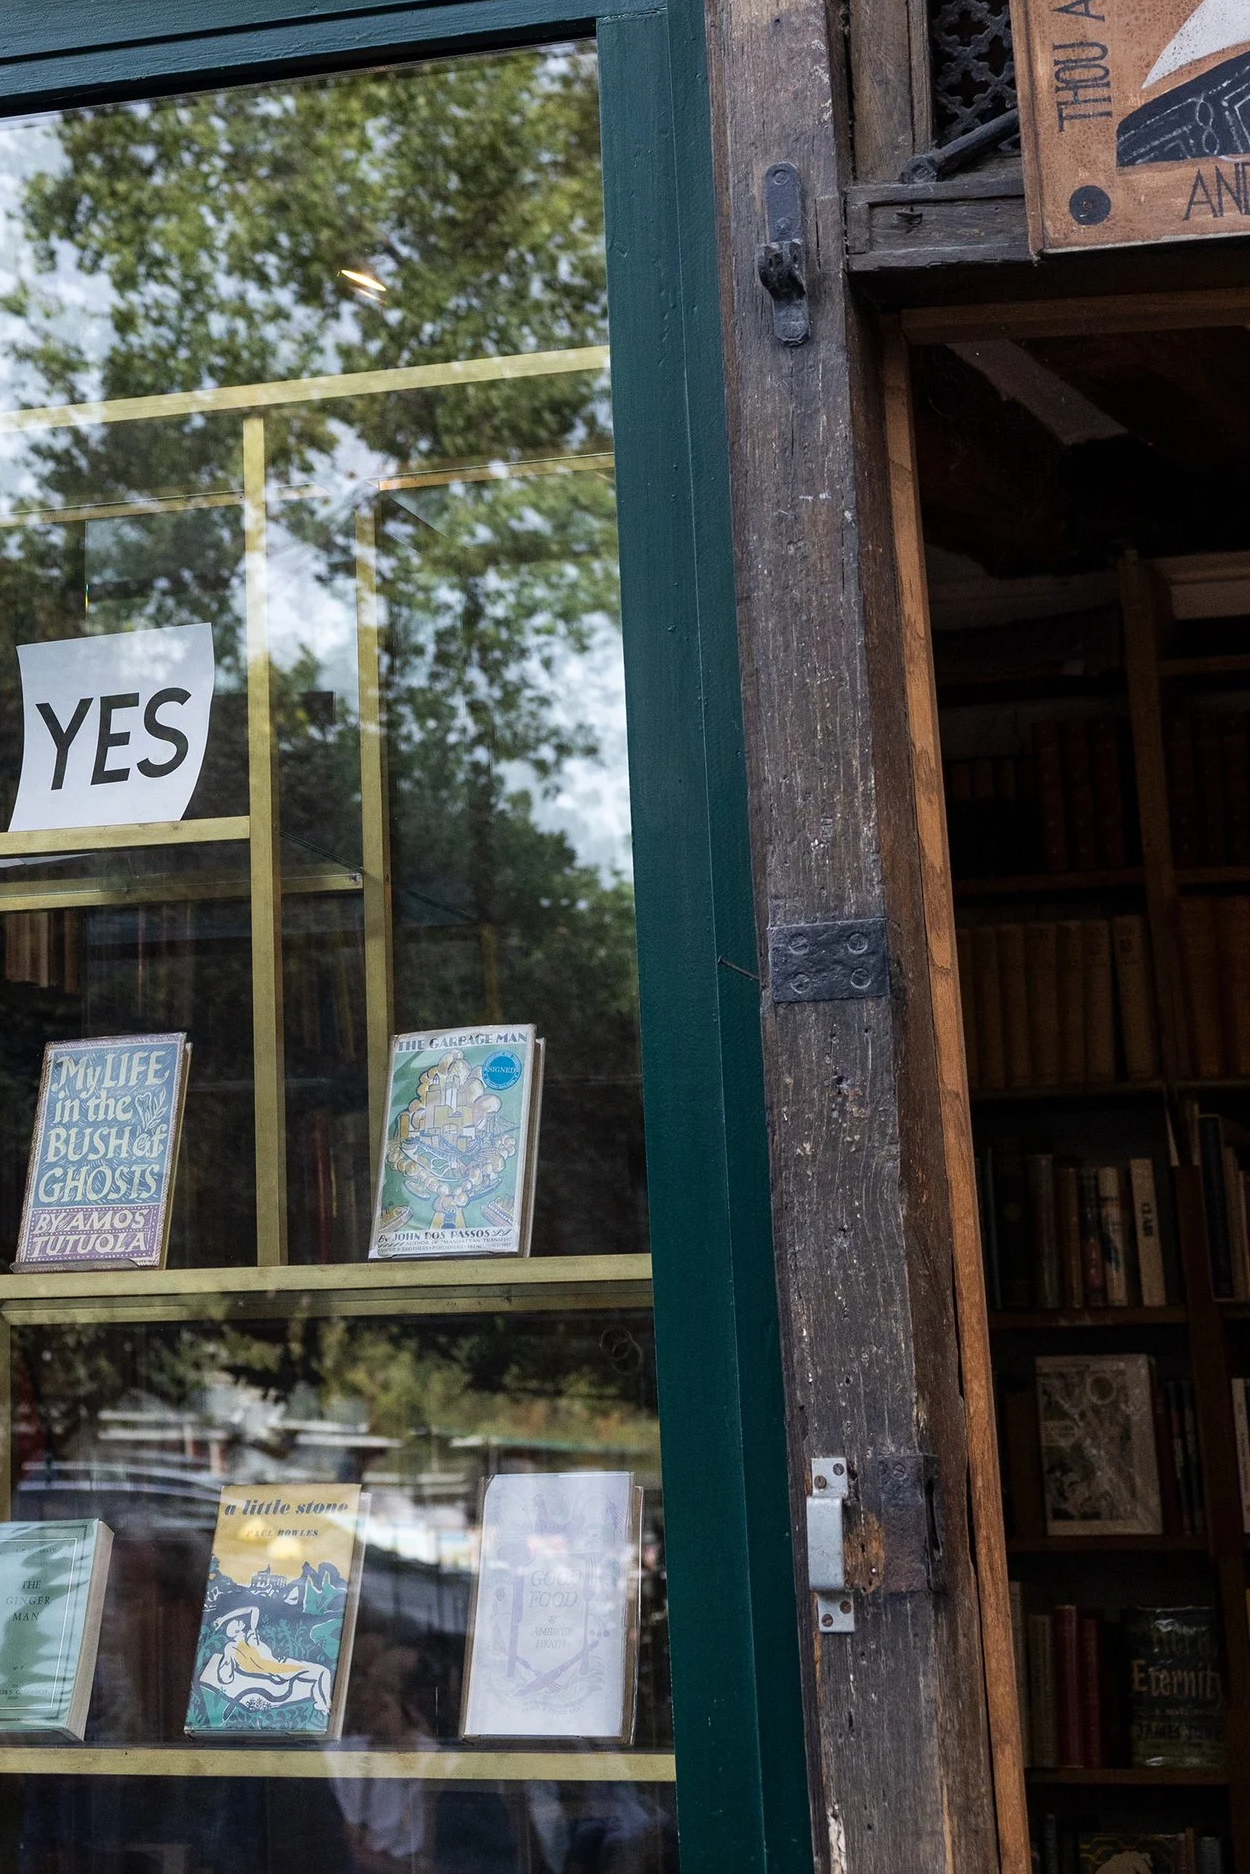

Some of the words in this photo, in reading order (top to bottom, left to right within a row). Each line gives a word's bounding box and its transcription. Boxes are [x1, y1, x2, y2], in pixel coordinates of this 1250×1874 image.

[1057, 40, 1112, 133] THOU
[34, 687, 192, 791] YES
[398, 1039, 425, 1052] THE
[430, 1033, 494, 1049] GARBAGE
[496, 1032, 528, 1044] MAN
[51, 1055, 103, 1098] My
[100, 1050, 170, 1088] LIFE
[489, 1066, 516, 1074] SIGNED
[52, 1090, 80, 1124] in
[86, 1088, 132, 1122] the
[45, 1124, 132, 1163] BUSH
[38, 1162, 160, 1203] GHOSTS
[32, 1210, 67, 1234] BY
[67, 1209, 149, 1230] AMOS
[29, 1233, 147, 1258] TUTUOLA
[393, 1232, 421, 1242] JOHN
[425, 1230, 445, 1240] DOS
[450, 1229, 490, 1239] PASSOS
[224, 1504, 237, 1515] a
[242, 1499, 291, 1516] little
[295, 1500, 349, 1515] stone
[277, 1529, 319, 1537] BOWLES
[22, 1580, 42, 1590] THE
[530, 1570, 582, 1587] GOOD
[6, 1596, 51, 1606] GINGER
[529, 1591, 578, 1607] FOOD
[12, 1612, 40, 1622] MAN
[1129, 1658, 1224, 1710] Eternity
